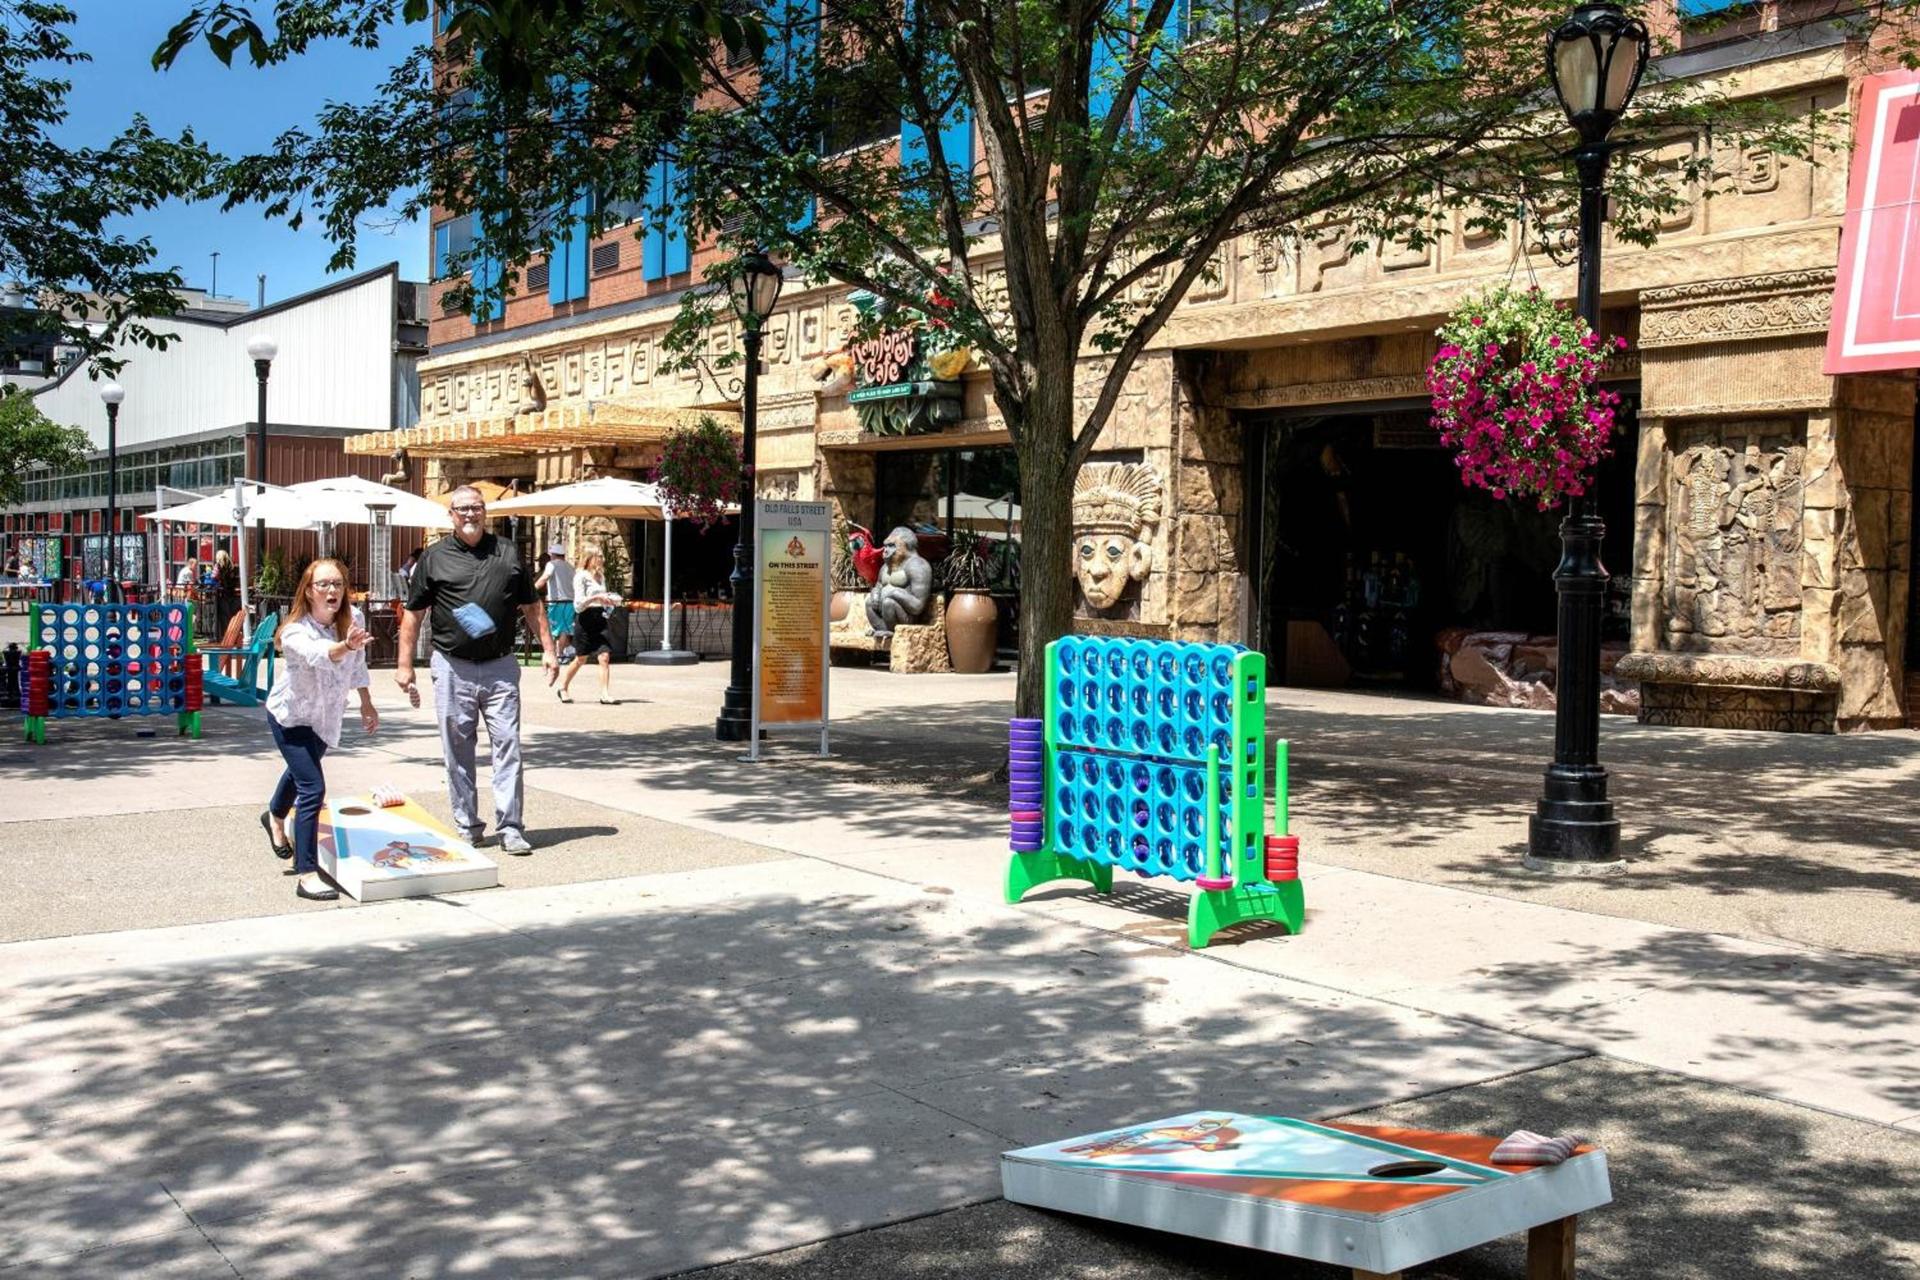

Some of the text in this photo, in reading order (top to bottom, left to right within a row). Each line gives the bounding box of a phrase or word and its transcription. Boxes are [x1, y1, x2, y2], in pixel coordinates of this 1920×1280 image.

[864, 352, 900, 386] Cafe
[764, 504, 826, 515] OLD FALLS STREET
[788, 517, 802, 527] USA
